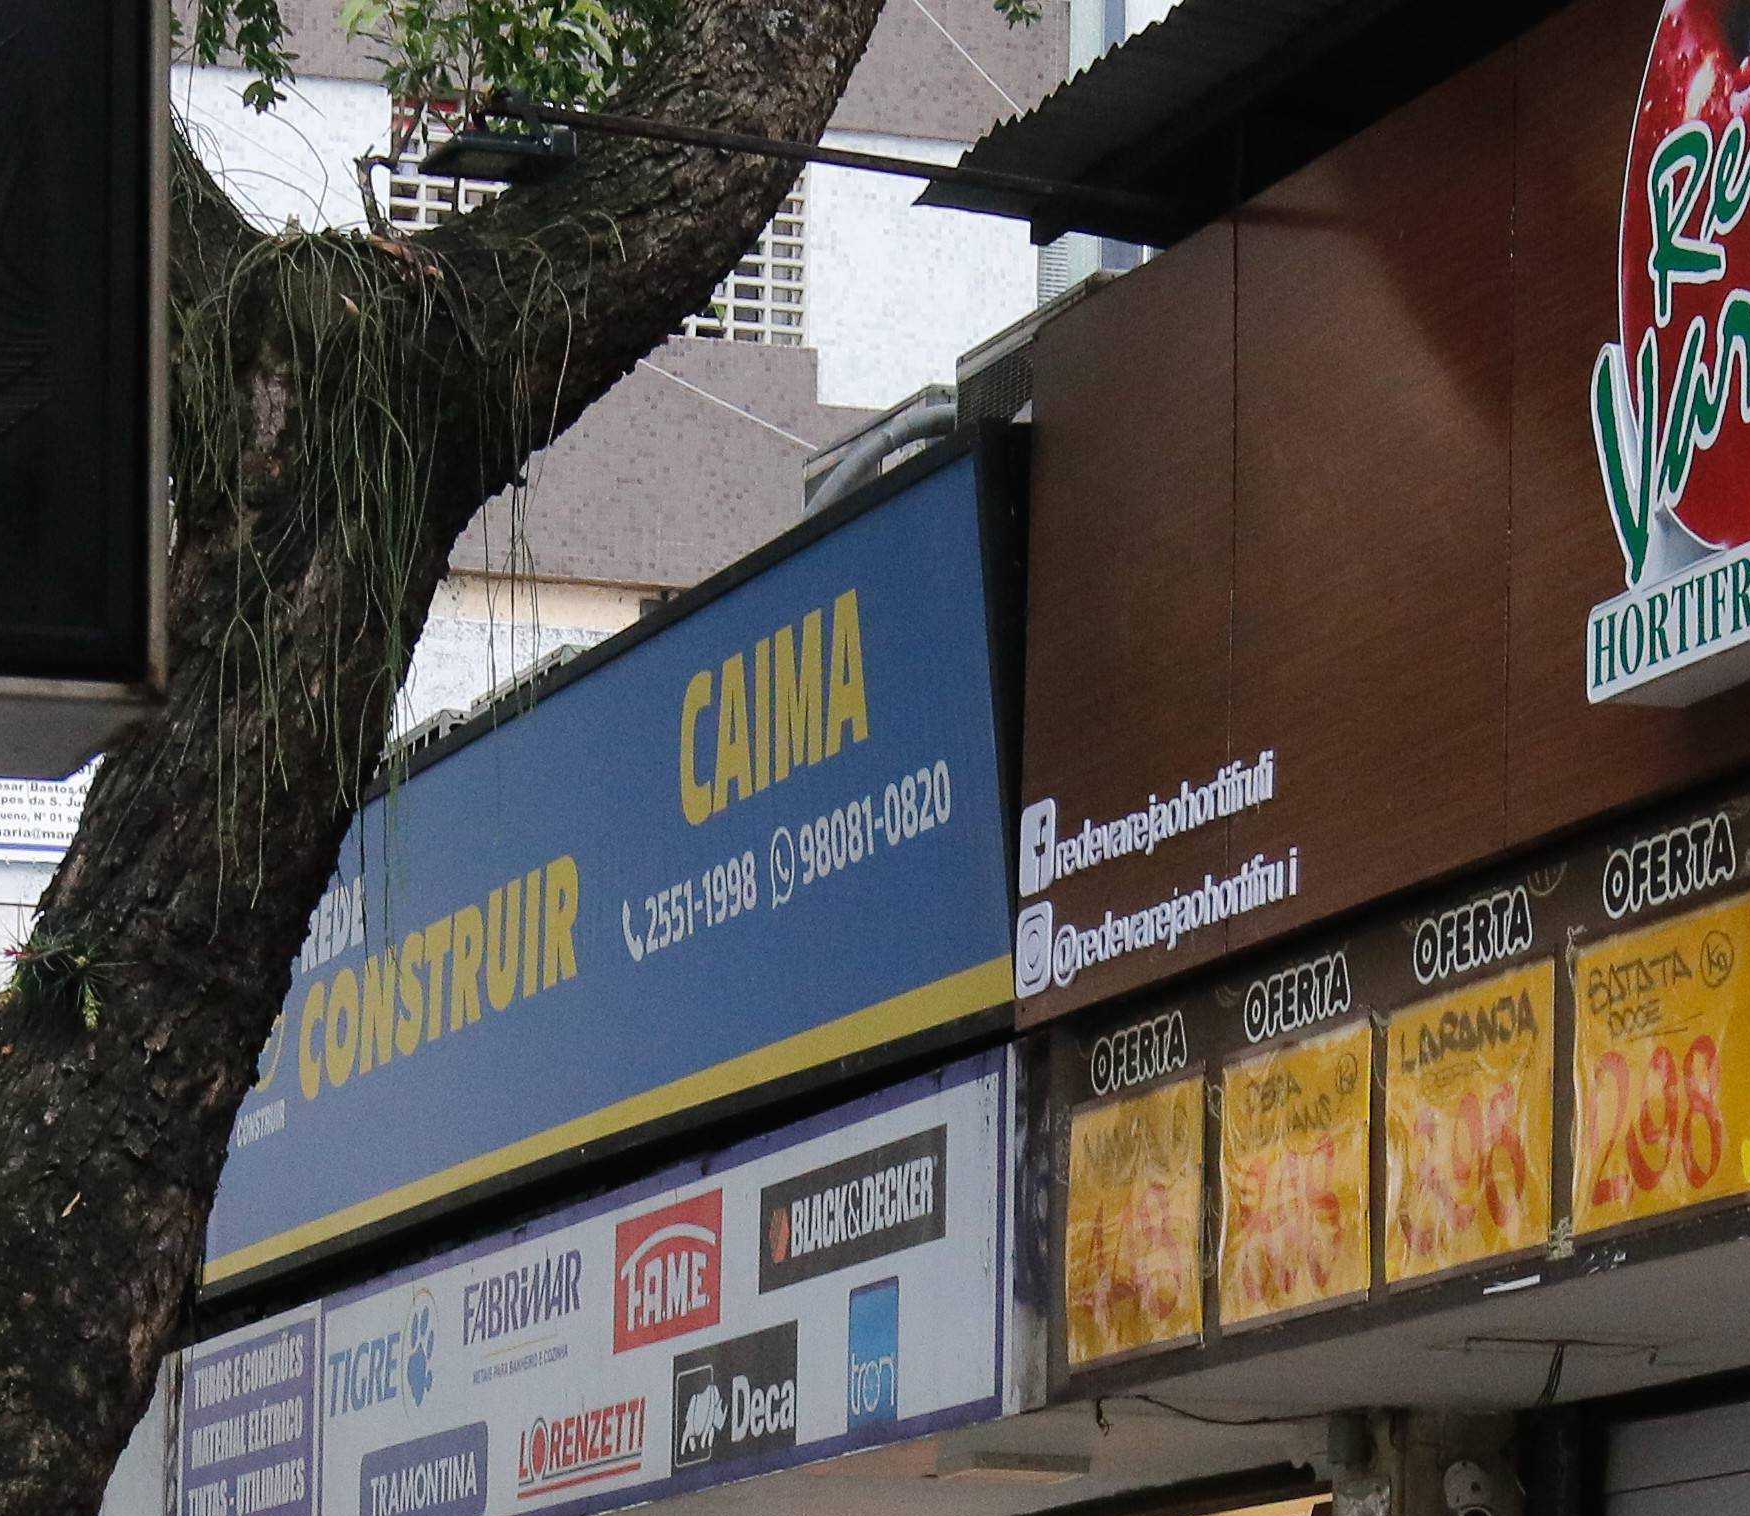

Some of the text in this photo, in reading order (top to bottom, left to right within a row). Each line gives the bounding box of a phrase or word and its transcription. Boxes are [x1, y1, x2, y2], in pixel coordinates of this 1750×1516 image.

[679, 588, 869, 827] CAIMA
[643, 760, 952, 956] 2551-1998 98081-0820
[1602, 812, 1736, 920] OFERTA
[298, 855, 580, 1102] CONSTRUIR
[1412, 884, 1534, 985] OFERTA
[1244, 951, 1351, 1044] OFERTA
[1587, 948, 1693, 1015] BATATA
[1091, 1010, 1188, 1095] OFERTA
[1400, 986, 1540, 1075] LARANJA
[791, 1156, 935, 1258] BLACK&DECKER
[463, 1248, 581, 1346] FABRIMAR
[193, 1360, 232, 1410] TUBOS
[242, 1332, 305, 1392] CONEXÕES
[328, 1331, 400, 1418] TIGRE
[731, 1374, 795, 1443] Deca
[191, 1396, 303, 1470] MATERIAL ELÉTRICO
[517, 1396, 646, 1481] LORENZETTI
[236, 1457, 305, 1516] UTILIDADES
